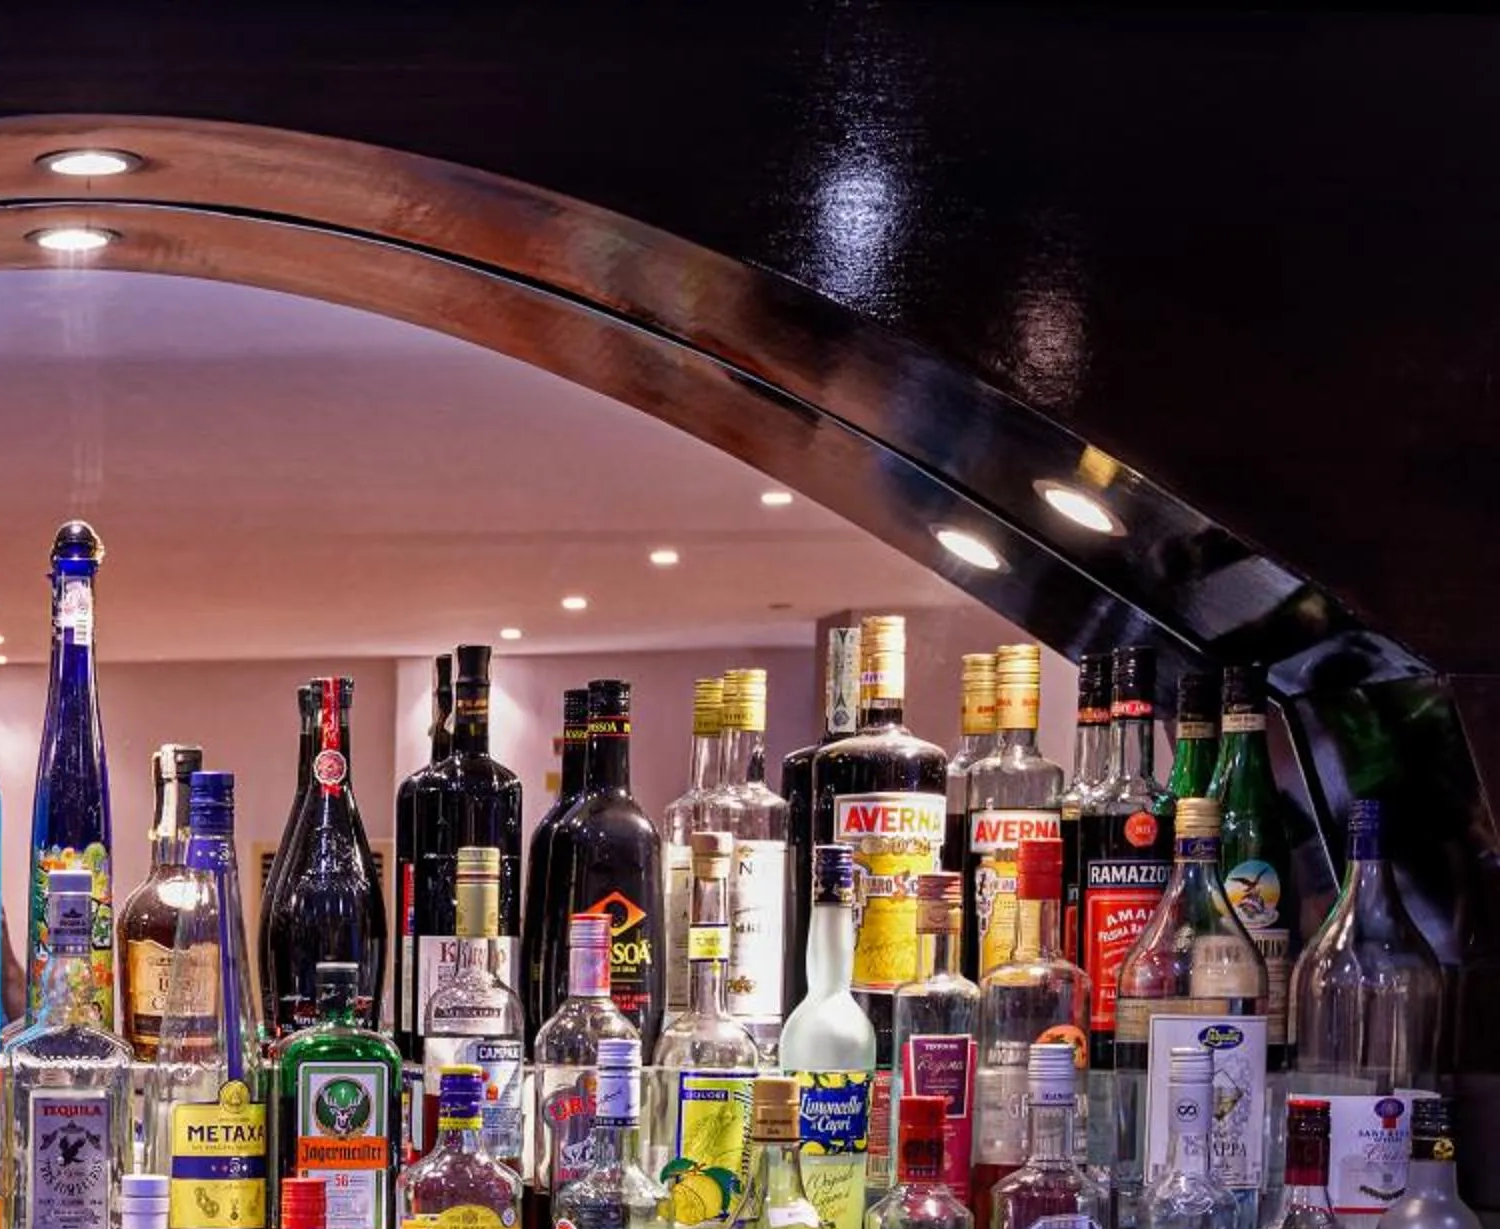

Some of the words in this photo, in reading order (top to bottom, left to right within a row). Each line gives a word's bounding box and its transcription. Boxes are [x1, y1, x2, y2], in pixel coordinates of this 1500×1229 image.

[1091, 865, 1172, 883] RAMAZZO
[42, 1105, 103, 1118] TEQUILA
[188, 1125, 264, 1142] METAXA
